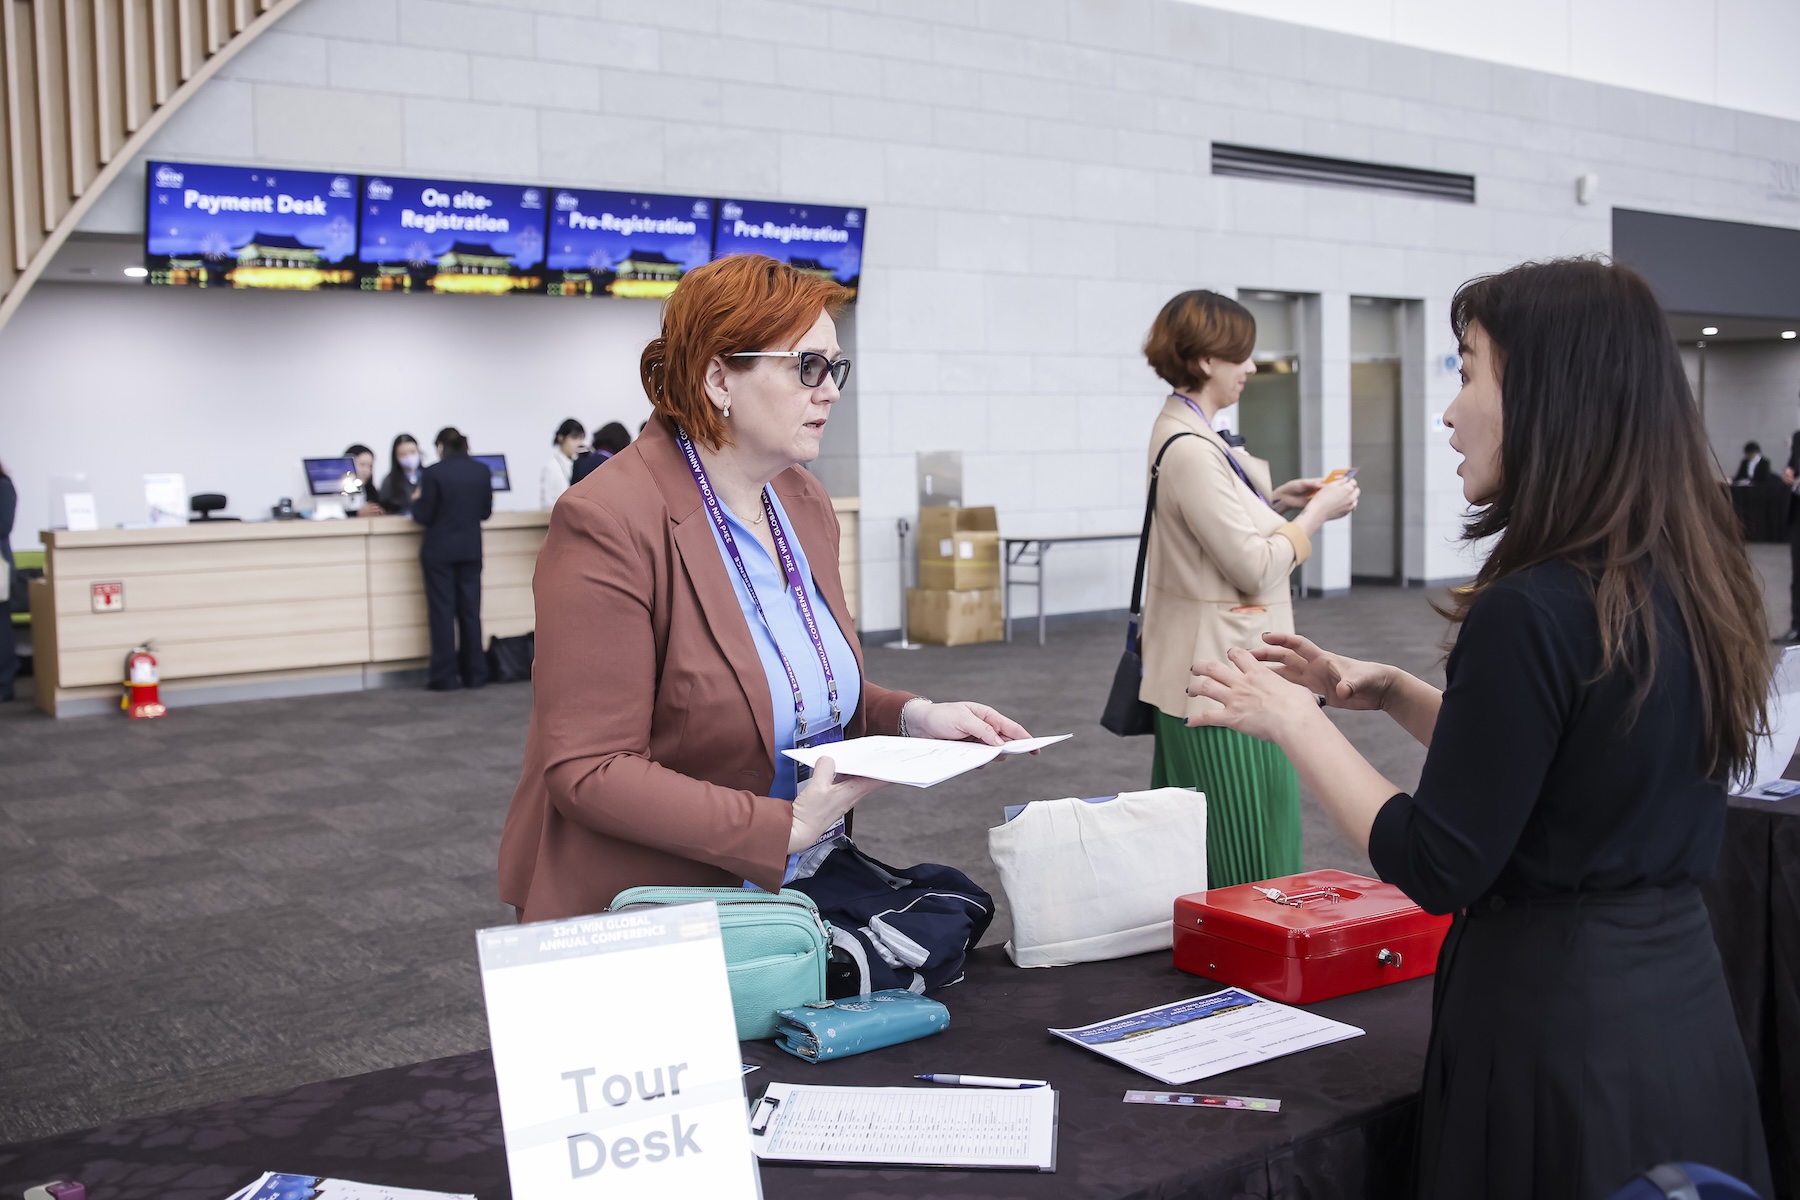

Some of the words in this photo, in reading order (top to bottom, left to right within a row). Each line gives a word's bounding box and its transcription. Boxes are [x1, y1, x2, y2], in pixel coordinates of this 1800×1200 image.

[184, 189, 273, 215] Payment
[277, 194, 327, 216] Desk
[421, 188, 450, 208] On
[453, 190, 492, 211] site-
[401, 209, 510, 233] Registration
[569, 211, 696, 236] Pre-Registration
[734, 220, 849, 243] Pre-Registration
[684, 440, 702, 473] ANNUAL
[698, 474, 715, 506] GLOBAL
[766, 502, 781, 537] GLOBAL
[720, 525, 732, 544] 33rd
[783, 553, 795, 573] 33rd
[794, 585, 819, 640] CONFERENCE
[816, 641, 831, 676] ANNUAL
[539, 936, 589, 952] ANNUAL
[591, 925, 667, 945] CONFERENCE
[552, 925, 578, 938] 33rd
[606, 915, 651, 930] GLOBAL
[560, 1062, 688, 1113] Tour
[567, 1114, 703, 1179] Desk
